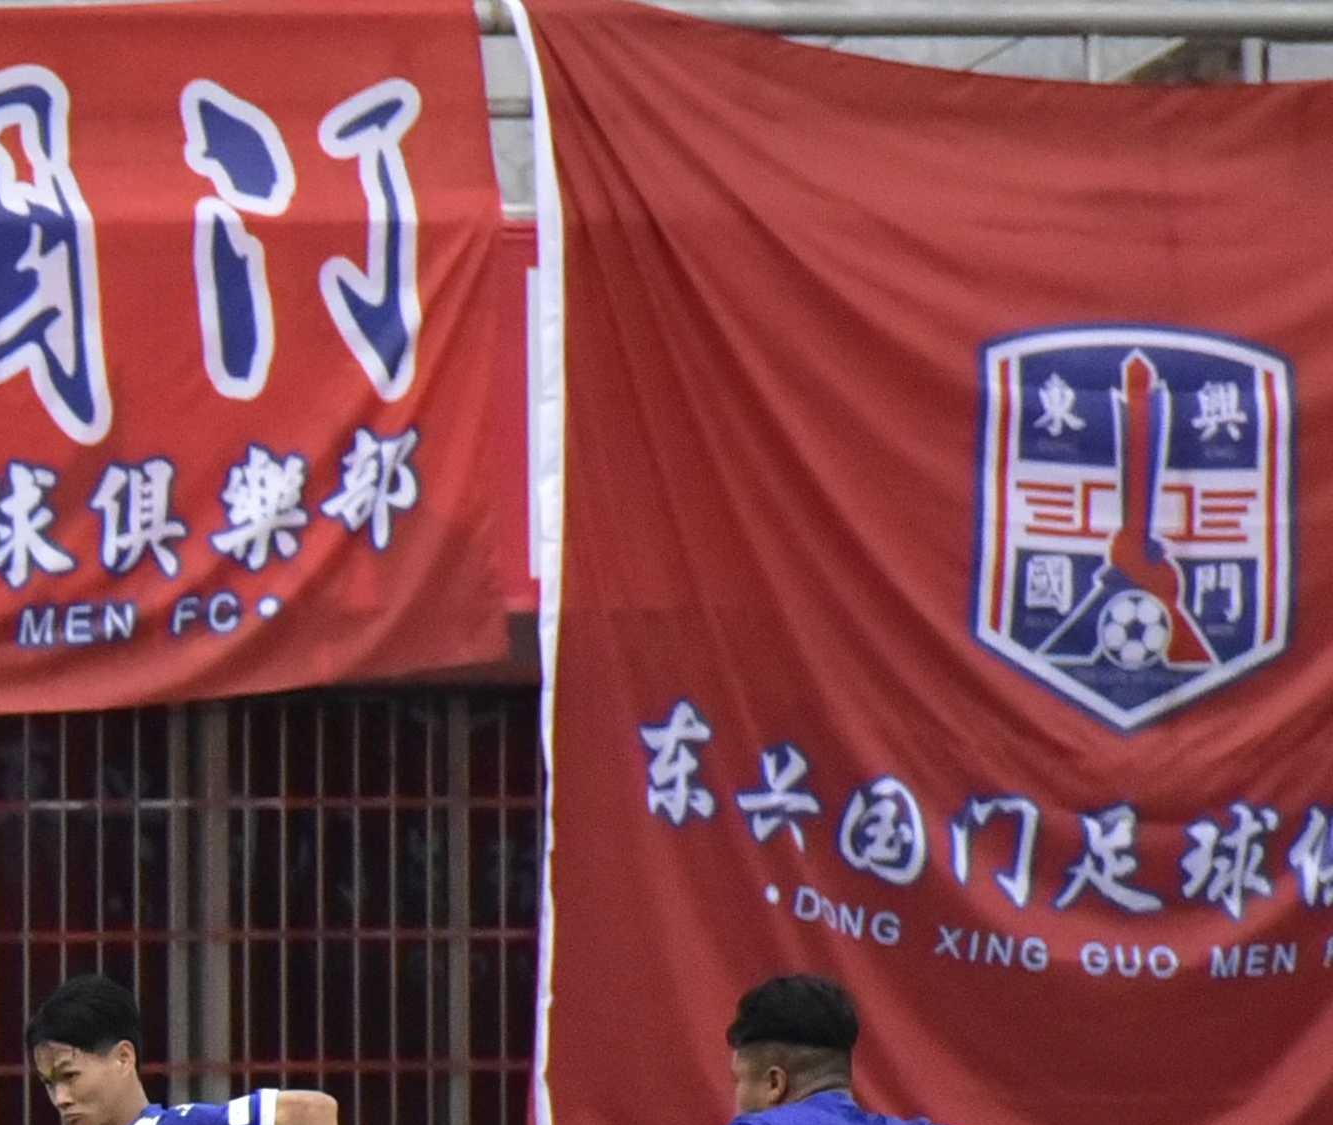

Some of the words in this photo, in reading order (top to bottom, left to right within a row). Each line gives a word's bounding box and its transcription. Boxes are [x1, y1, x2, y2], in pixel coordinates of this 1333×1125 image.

[1024, 554, 1073, 616] 國
[1193, 562, 1242, 623] 門
[17, 602, 135, 647] MEN
[170, 592, 241, 635] FC
[934, 925, 1050, 971] XING
[1079, 940, 1181, 979] GUO
[1209, 943, 1298, 979] MEN
